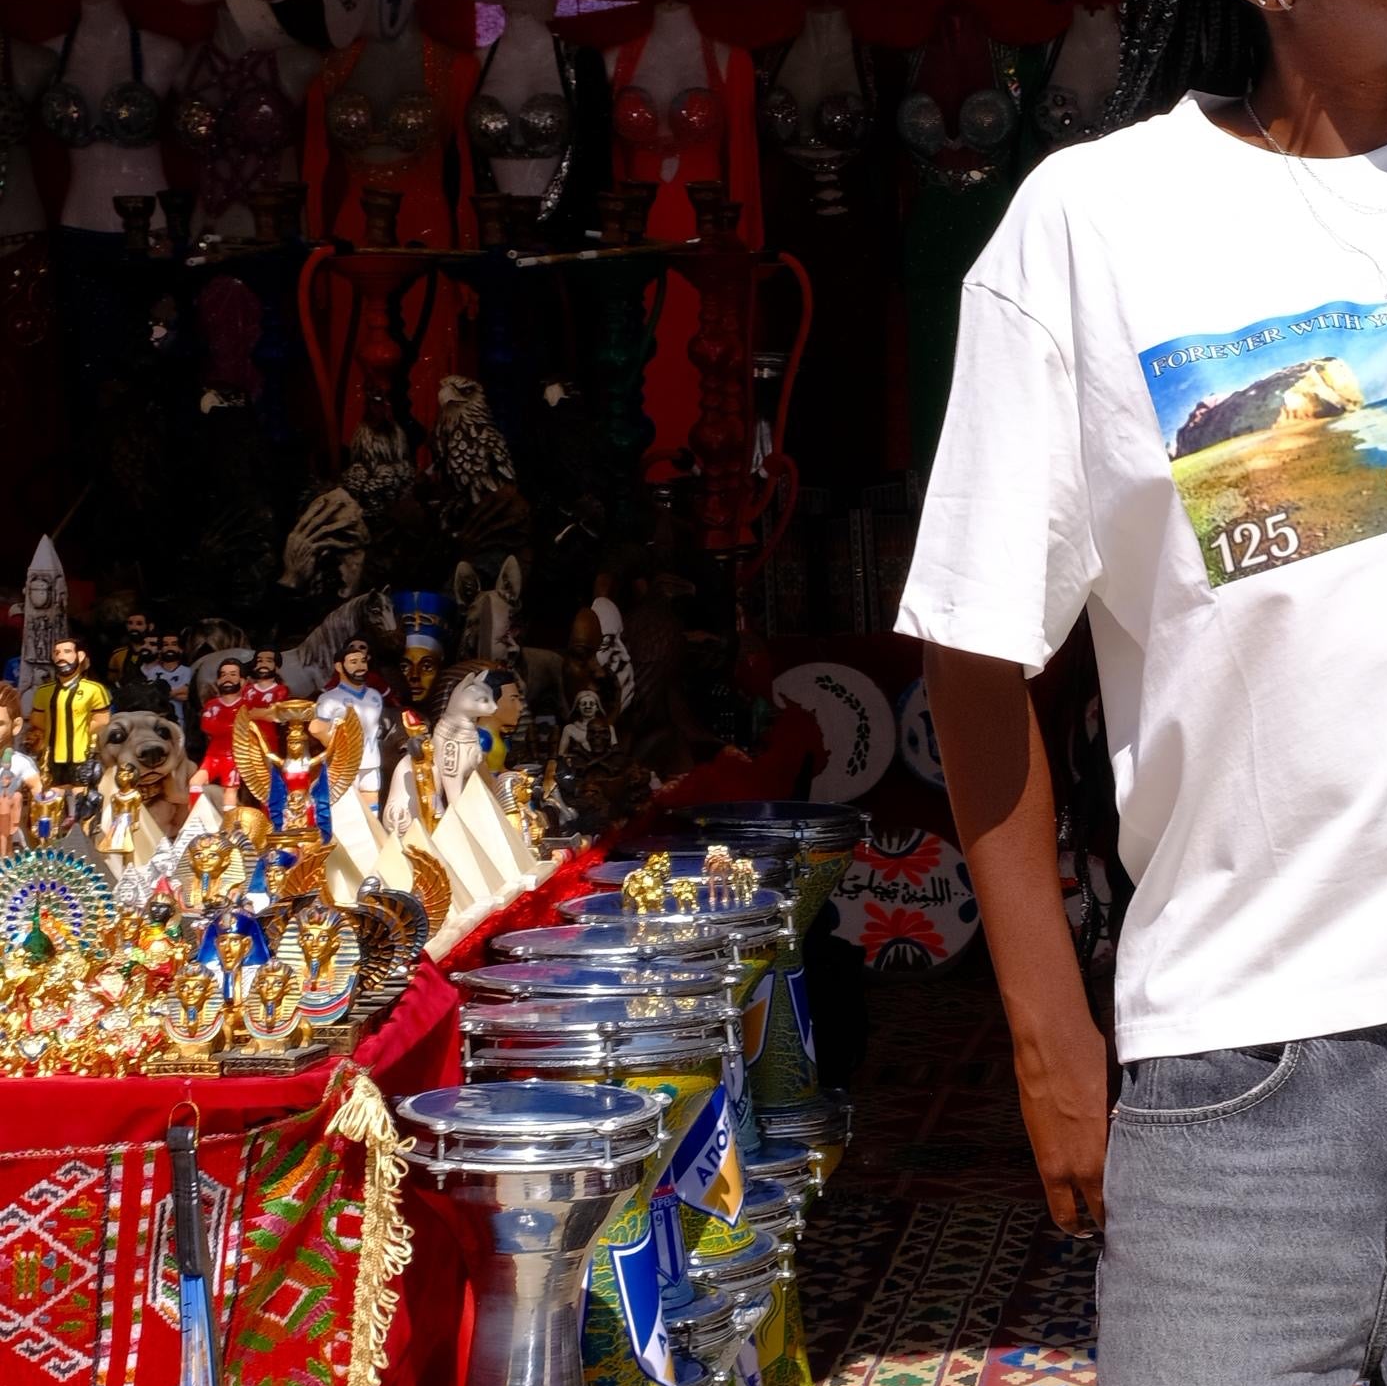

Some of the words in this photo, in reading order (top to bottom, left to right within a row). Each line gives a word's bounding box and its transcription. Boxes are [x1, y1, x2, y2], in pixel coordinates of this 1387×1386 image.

[1150, 327, 1285, 377] FOREVER
[1289, 313, 1364, 337] WITH
[1211, 513, 1300, 574] 125
